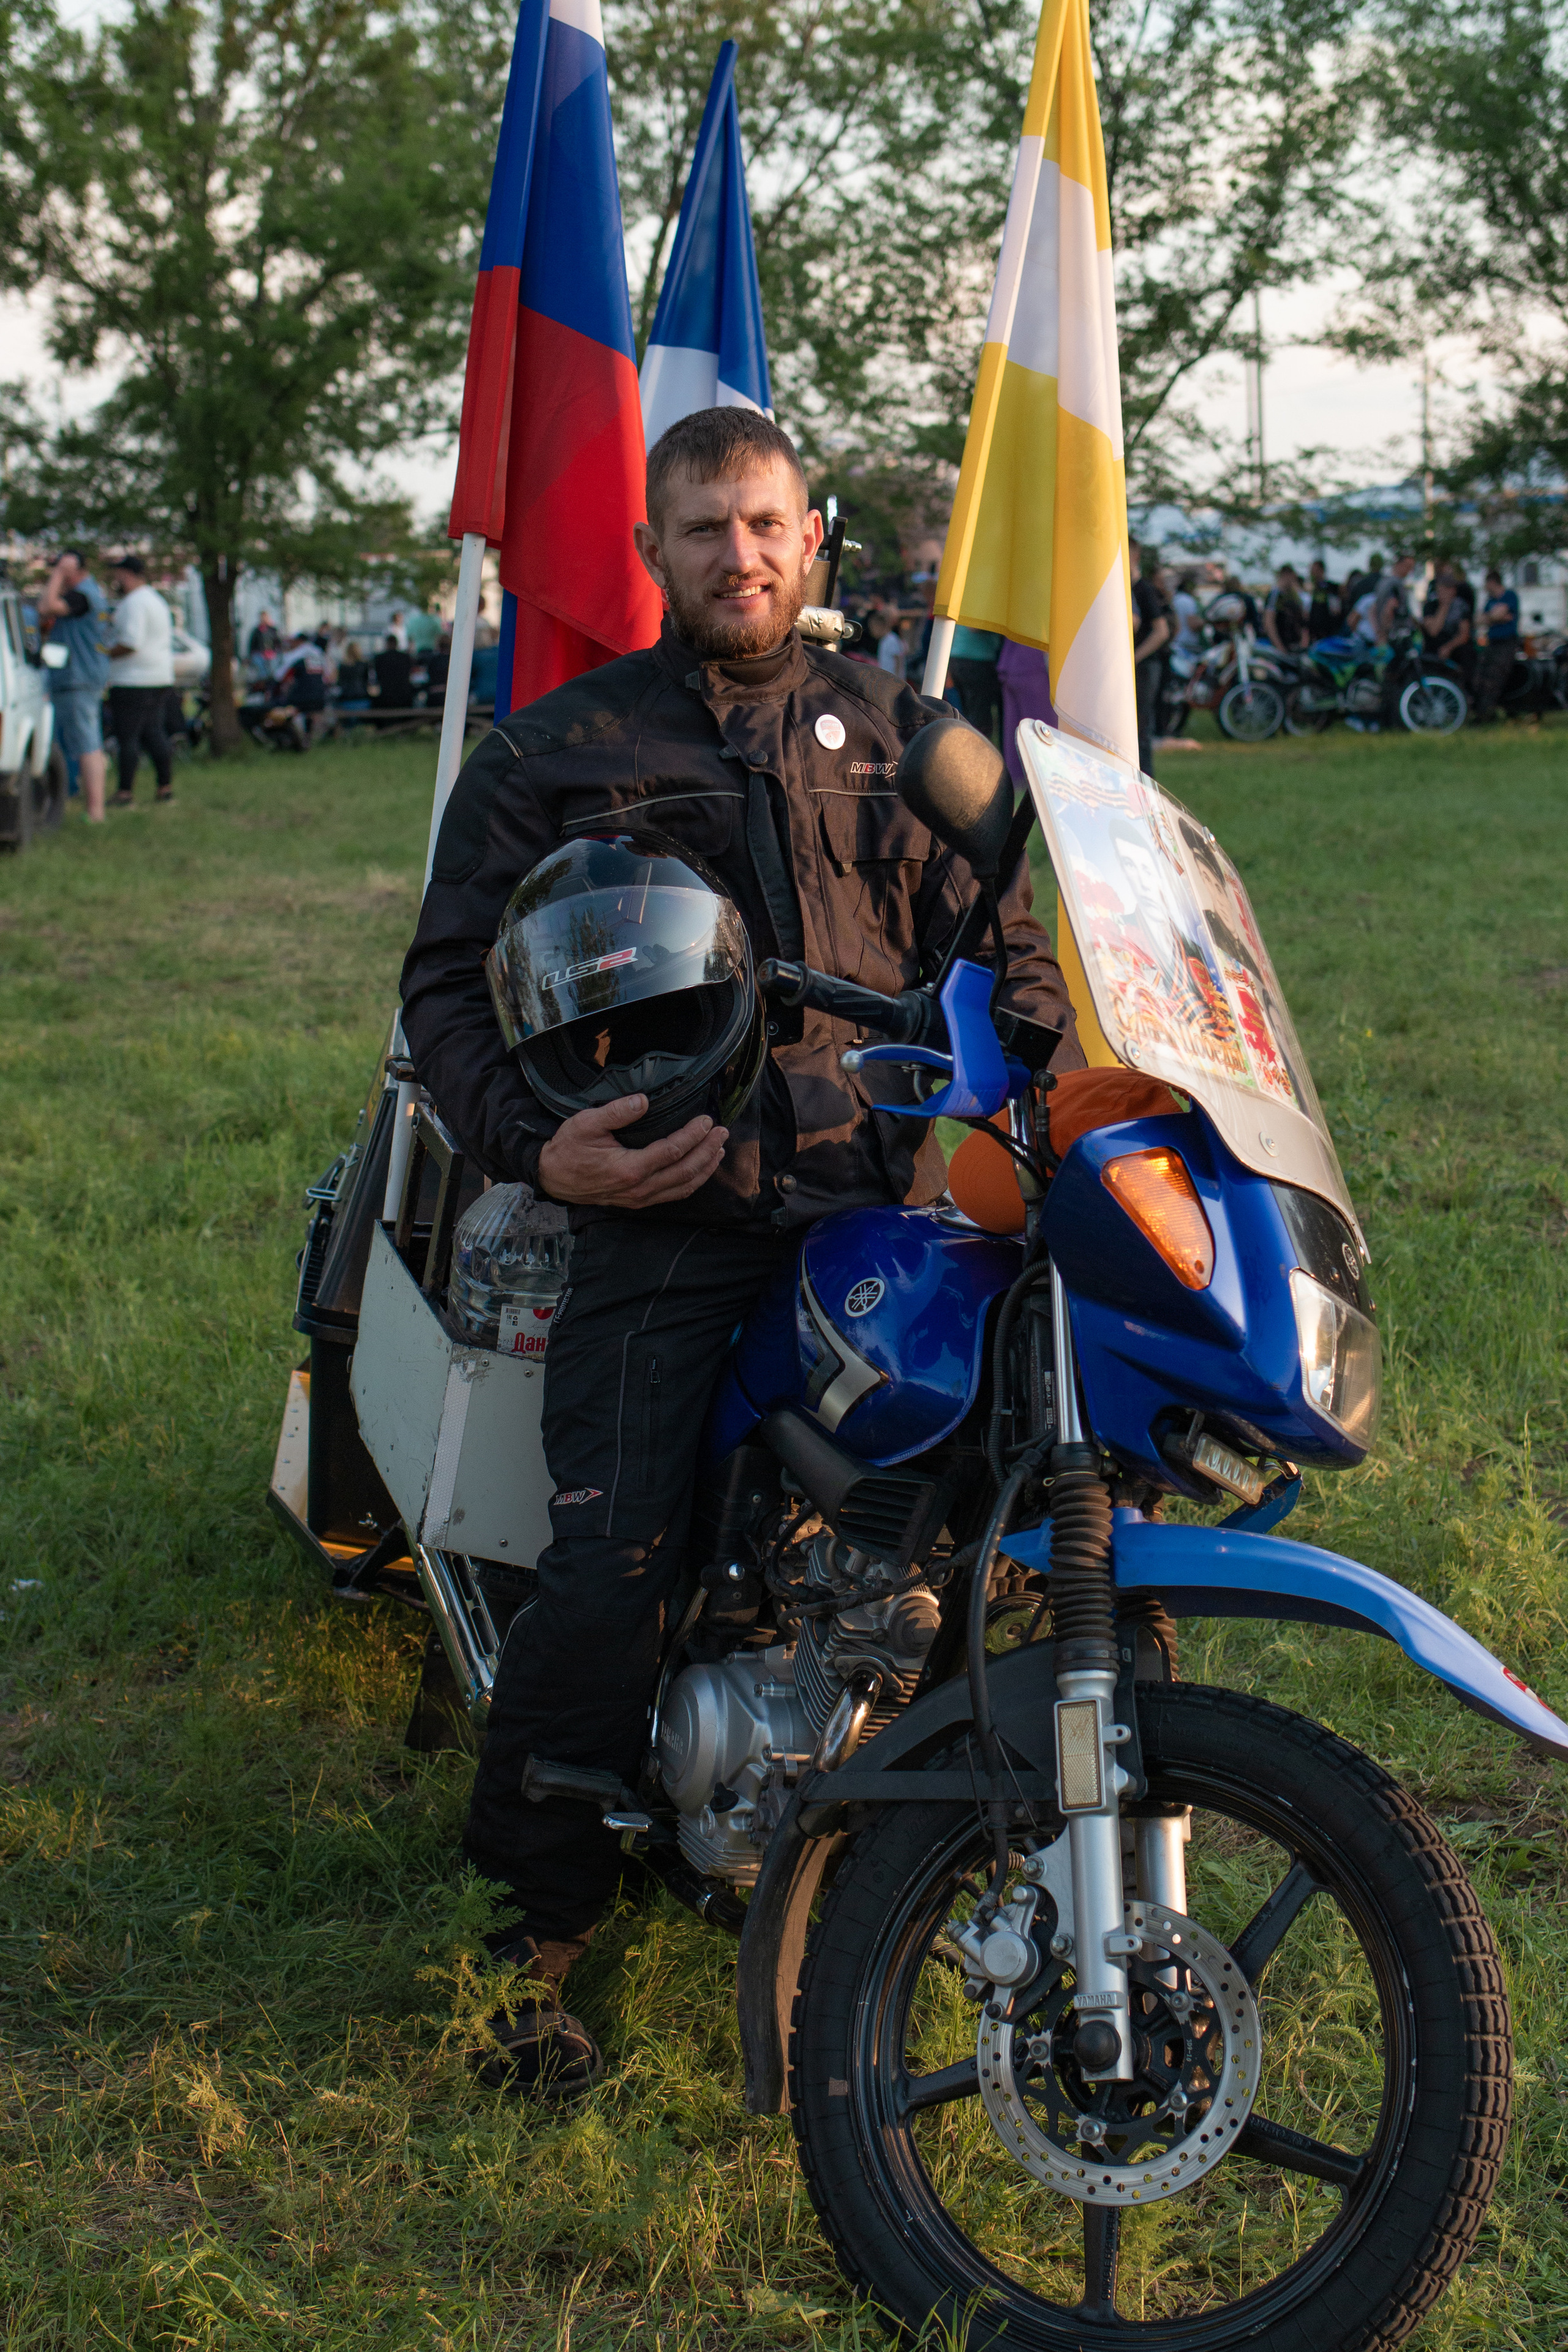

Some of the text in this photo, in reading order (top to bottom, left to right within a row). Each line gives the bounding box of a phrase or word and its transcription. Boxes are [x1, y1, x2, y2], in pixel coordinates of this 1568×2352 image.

[850, 761, 893, 775] MBW
[541, 946, 638, 991] LS2
[558, 1287, 574, 1316] PROTECTOR
[511, 1332, 549, 1354] Дан
[554, 1490, 586, 1506] MBW
[1077, 1994, 1113, 2007] YAMAHA
